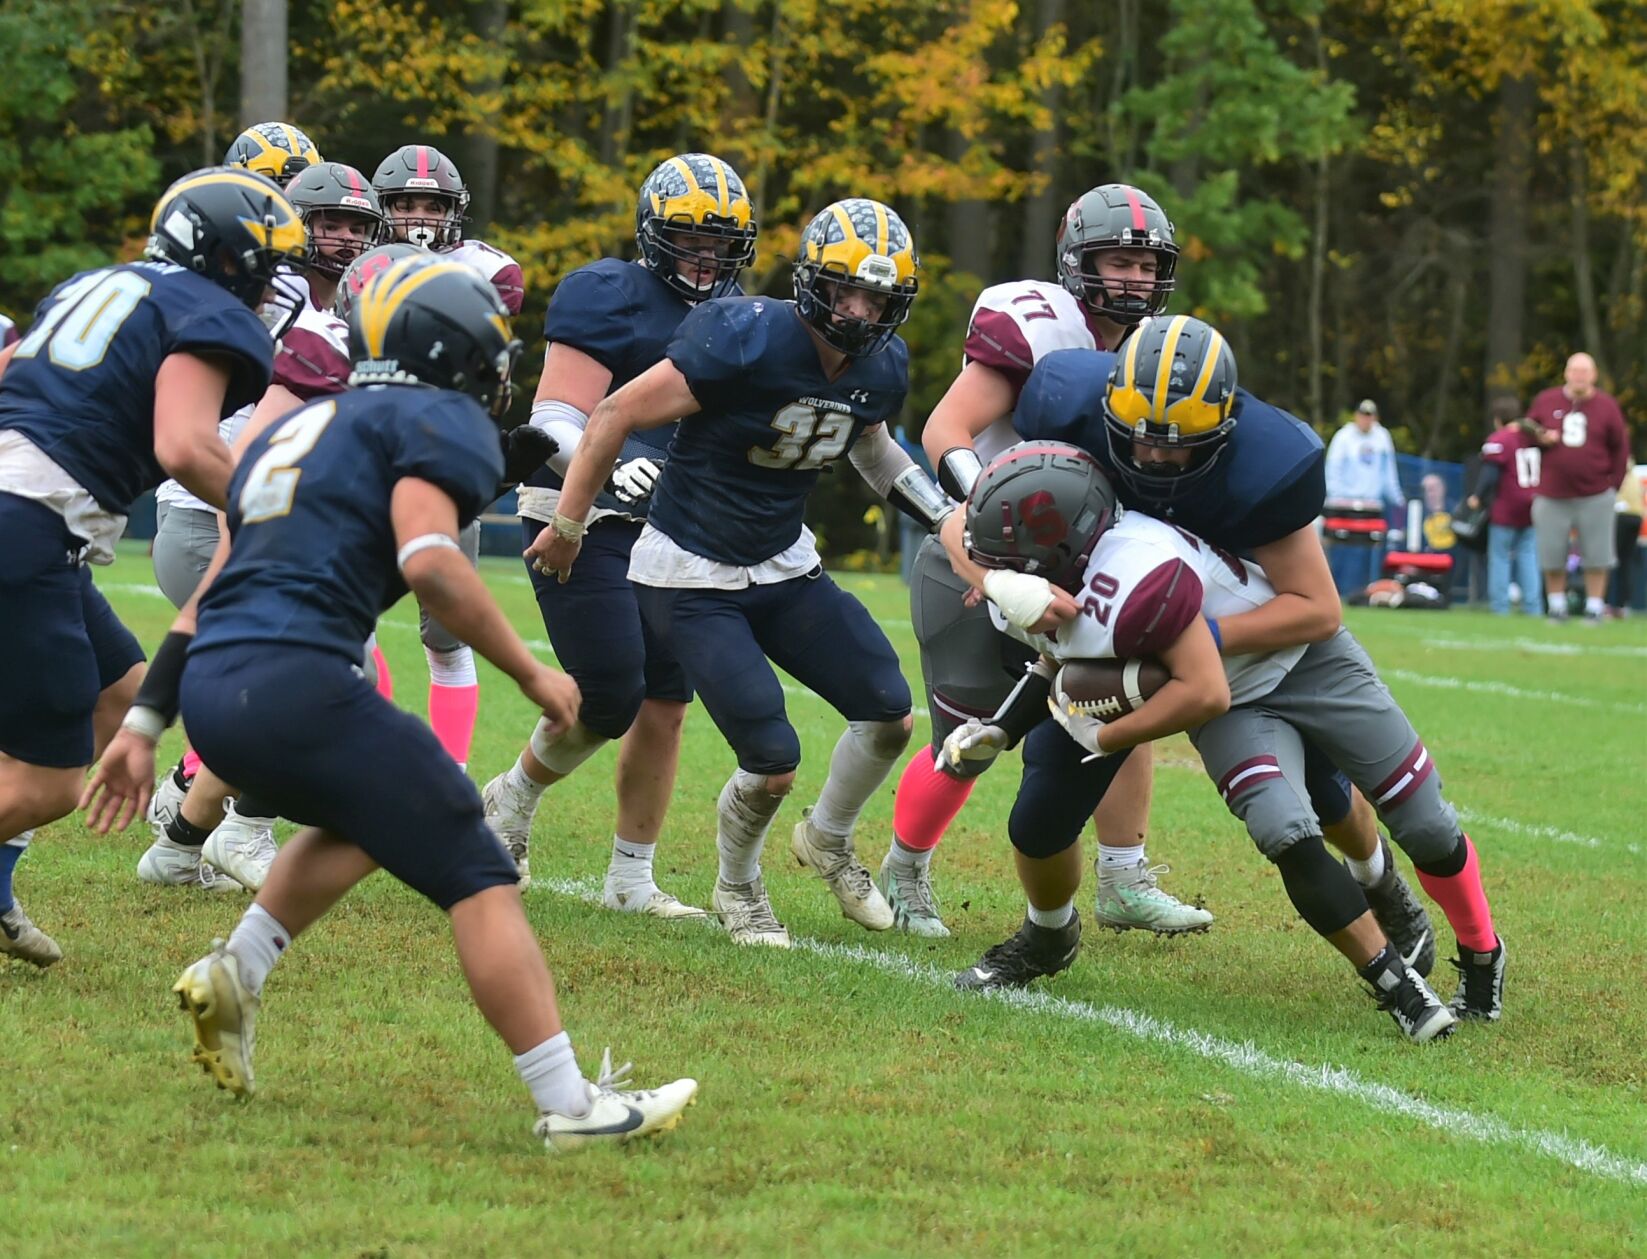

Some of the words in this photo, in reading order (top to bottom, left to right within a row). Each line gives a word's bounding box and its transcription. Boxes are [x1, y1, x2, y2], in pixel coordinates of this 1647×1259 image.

[1011, 289, 1058, 322] 77
[746, 402, 856, 471] 32
[1562, 411, 1588, 448] S
[239, 399, 338, 524] 2
[1018, 489, 1069, 548] S
[1083, 571, 1121, 628] 20
